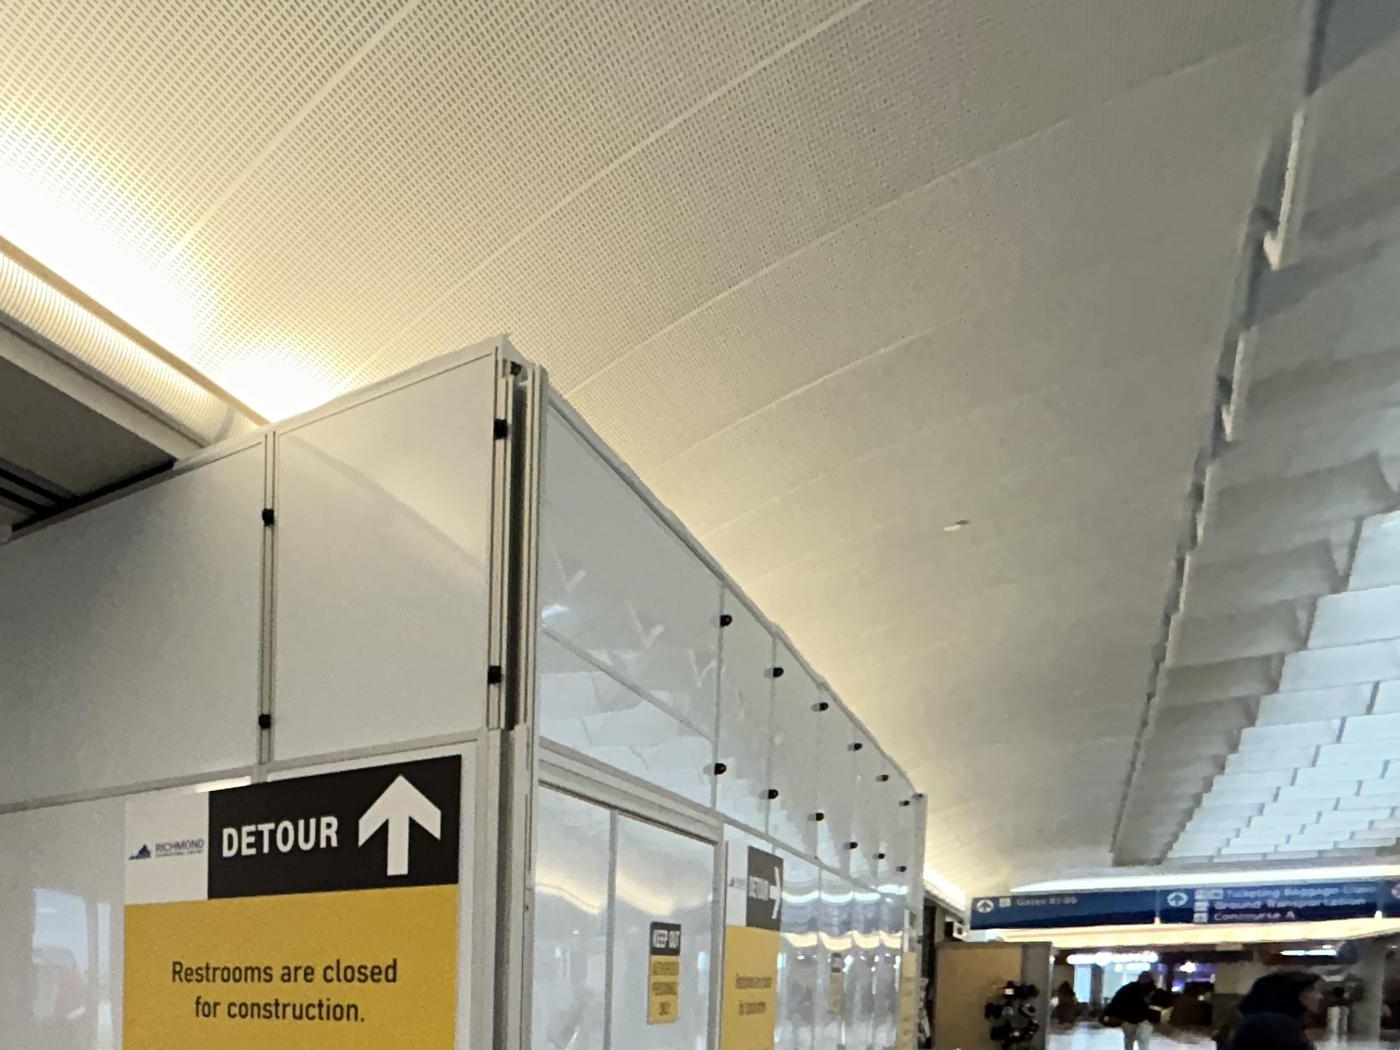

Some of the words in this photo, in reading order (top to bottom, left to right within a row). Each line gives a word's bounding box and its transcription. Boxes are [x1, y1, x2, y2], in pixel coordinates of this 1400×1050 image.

[155, 838, 205, 852] RICHMOND
[222, 815, 339, 858] DETOUR
[1285, 910, 1296, 920] A
[171, 960, 274, 984] Restrooms
[280, 964, 315, 984] are
[322, 958, 398, 984] closed
[194, 995, 221, 1018] for
[227, 997, 365, 1022] construction.
